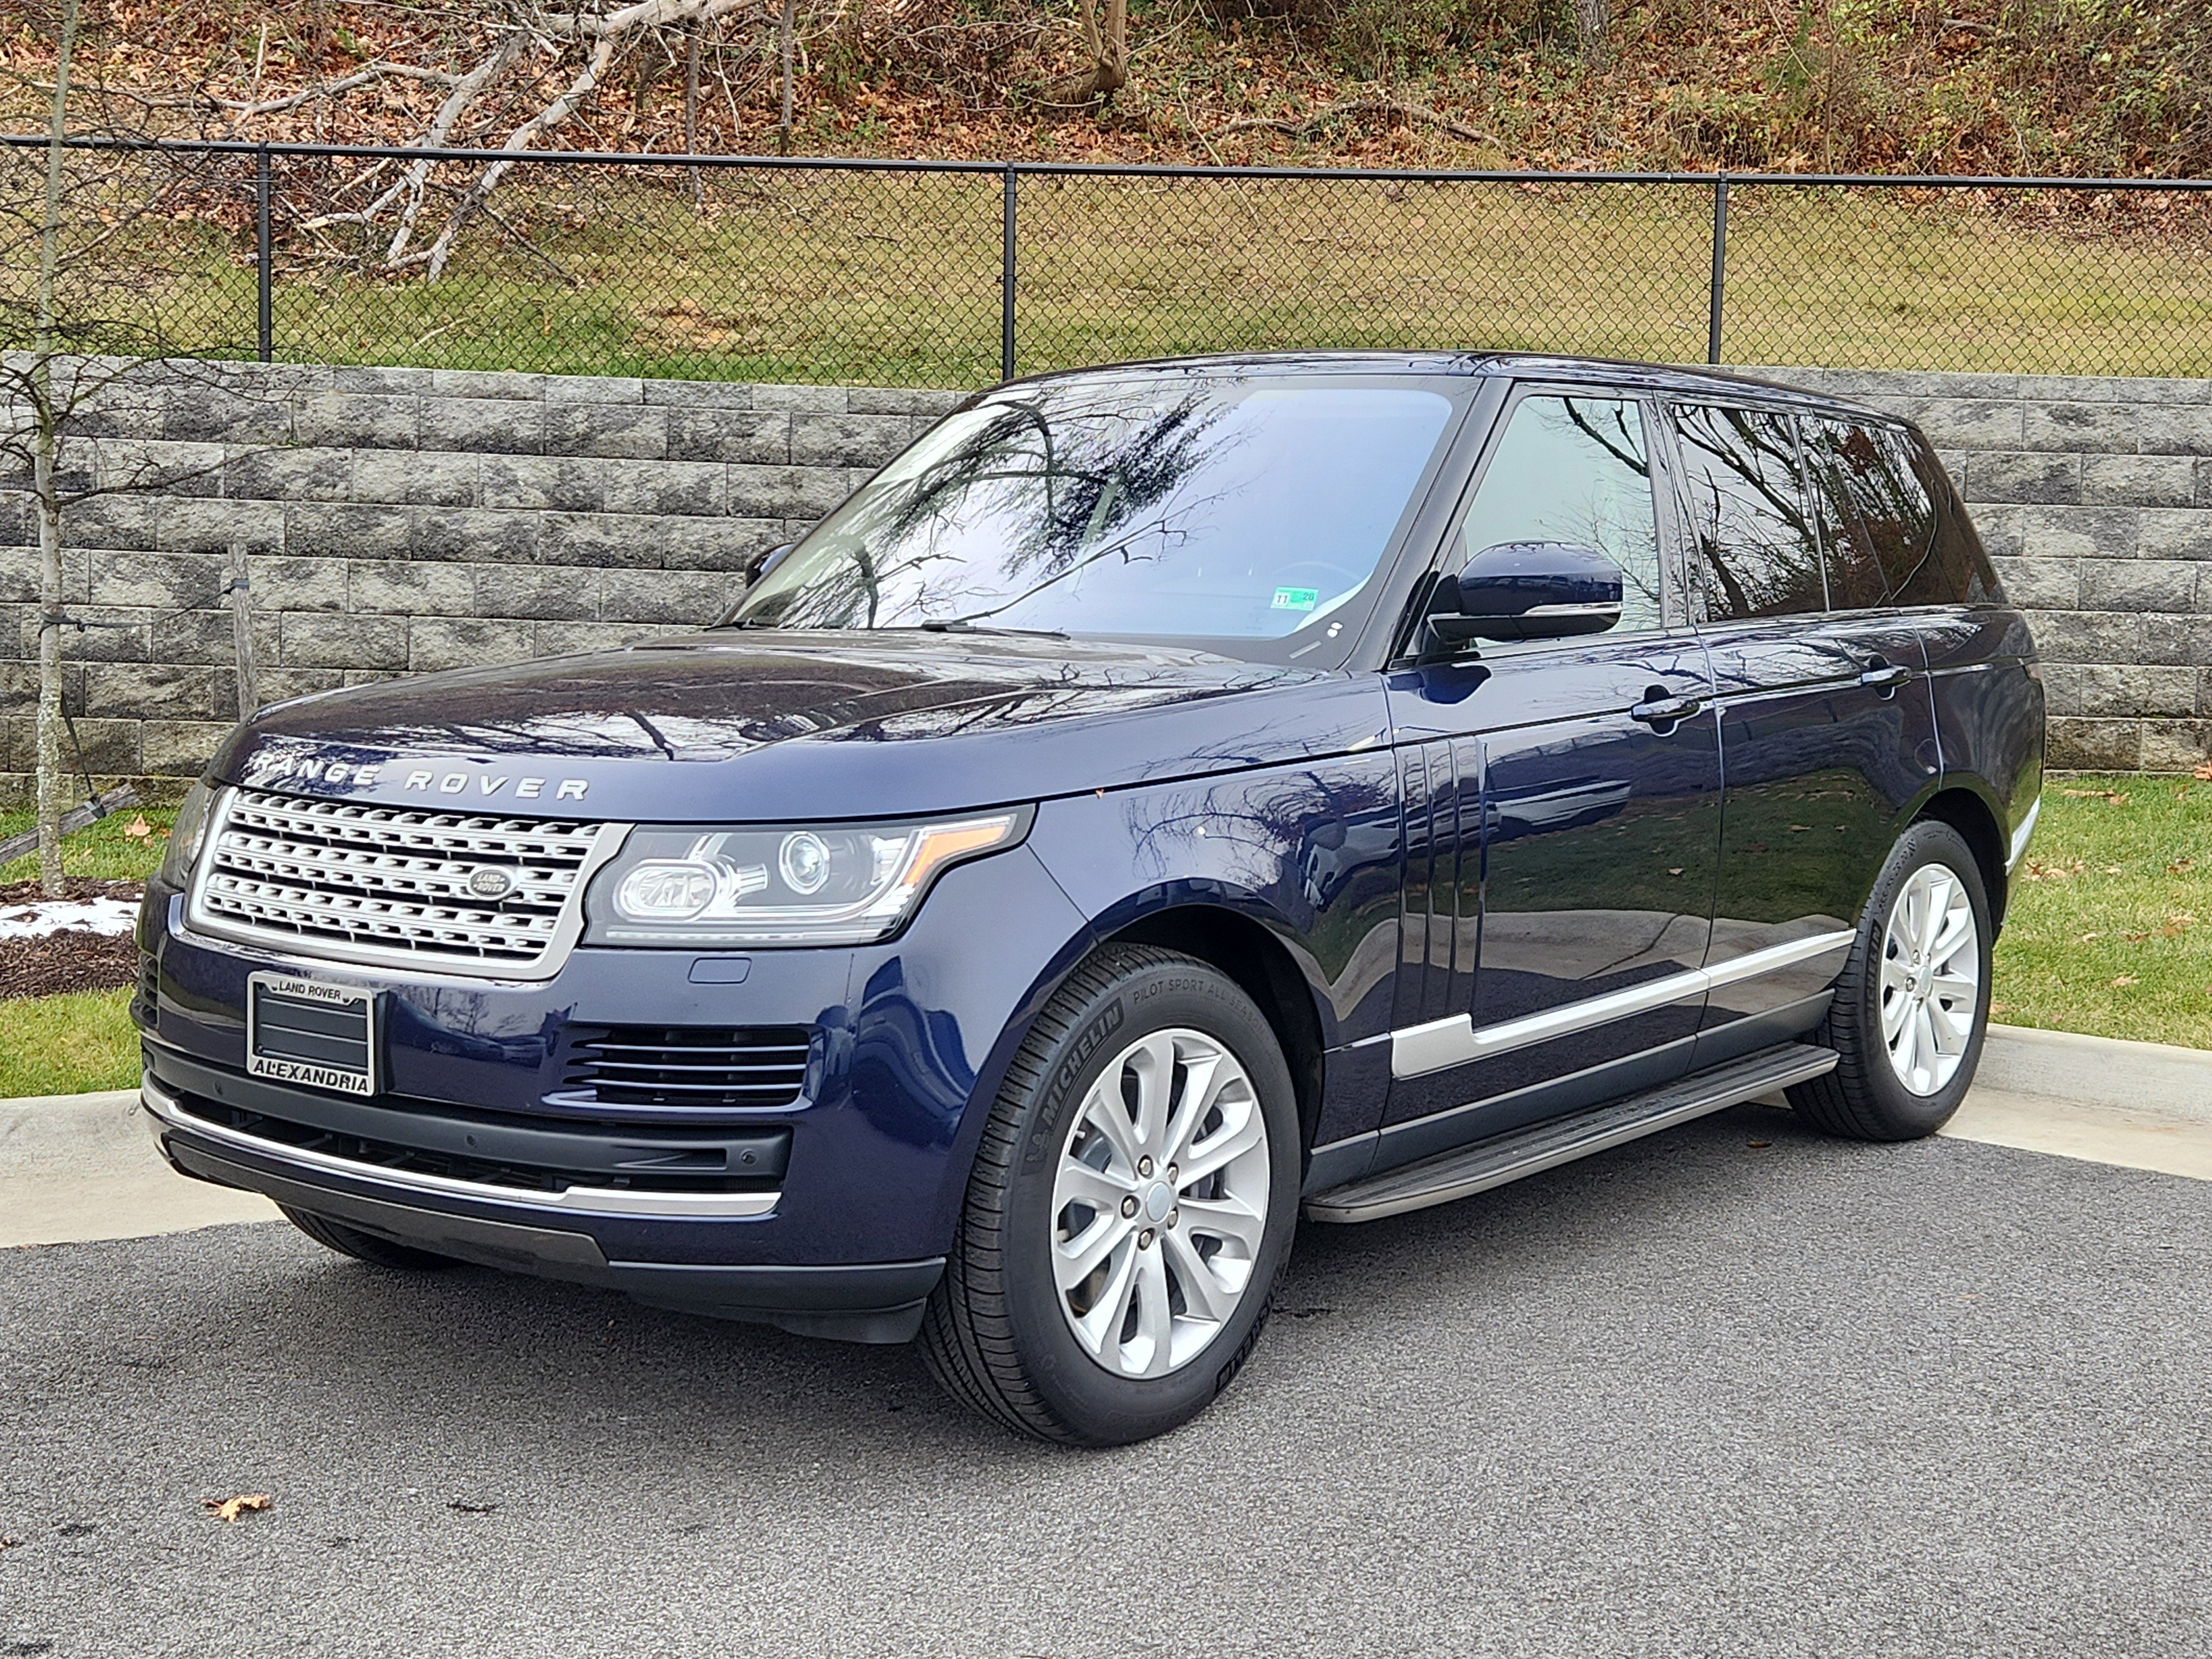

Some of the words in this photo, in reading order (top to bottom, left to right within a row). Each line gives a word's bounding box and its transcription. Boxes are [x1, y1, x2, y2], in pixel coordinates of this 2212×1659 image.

[1277, 595, 1288, 603] 11
[252, 753, 381, 786] RANGE
[404, 770, 589, 801] ROVER
[477, 873, 500, 883] LAND
[477, 882, 505, 892] ROVER
[279, 980, 305, 994] LAND
[308, 986, 341, 1000] ROVER
[1133, 981, 1163, 1004] PILOT
[1168, 979, 1204, 992] SPORT
[1207, 986, 1226, 1000] ALL
[253, 1059, 369, 1092] ALEXANDRIA
[1042, 1005, 1121, 1127] MICHELIN
